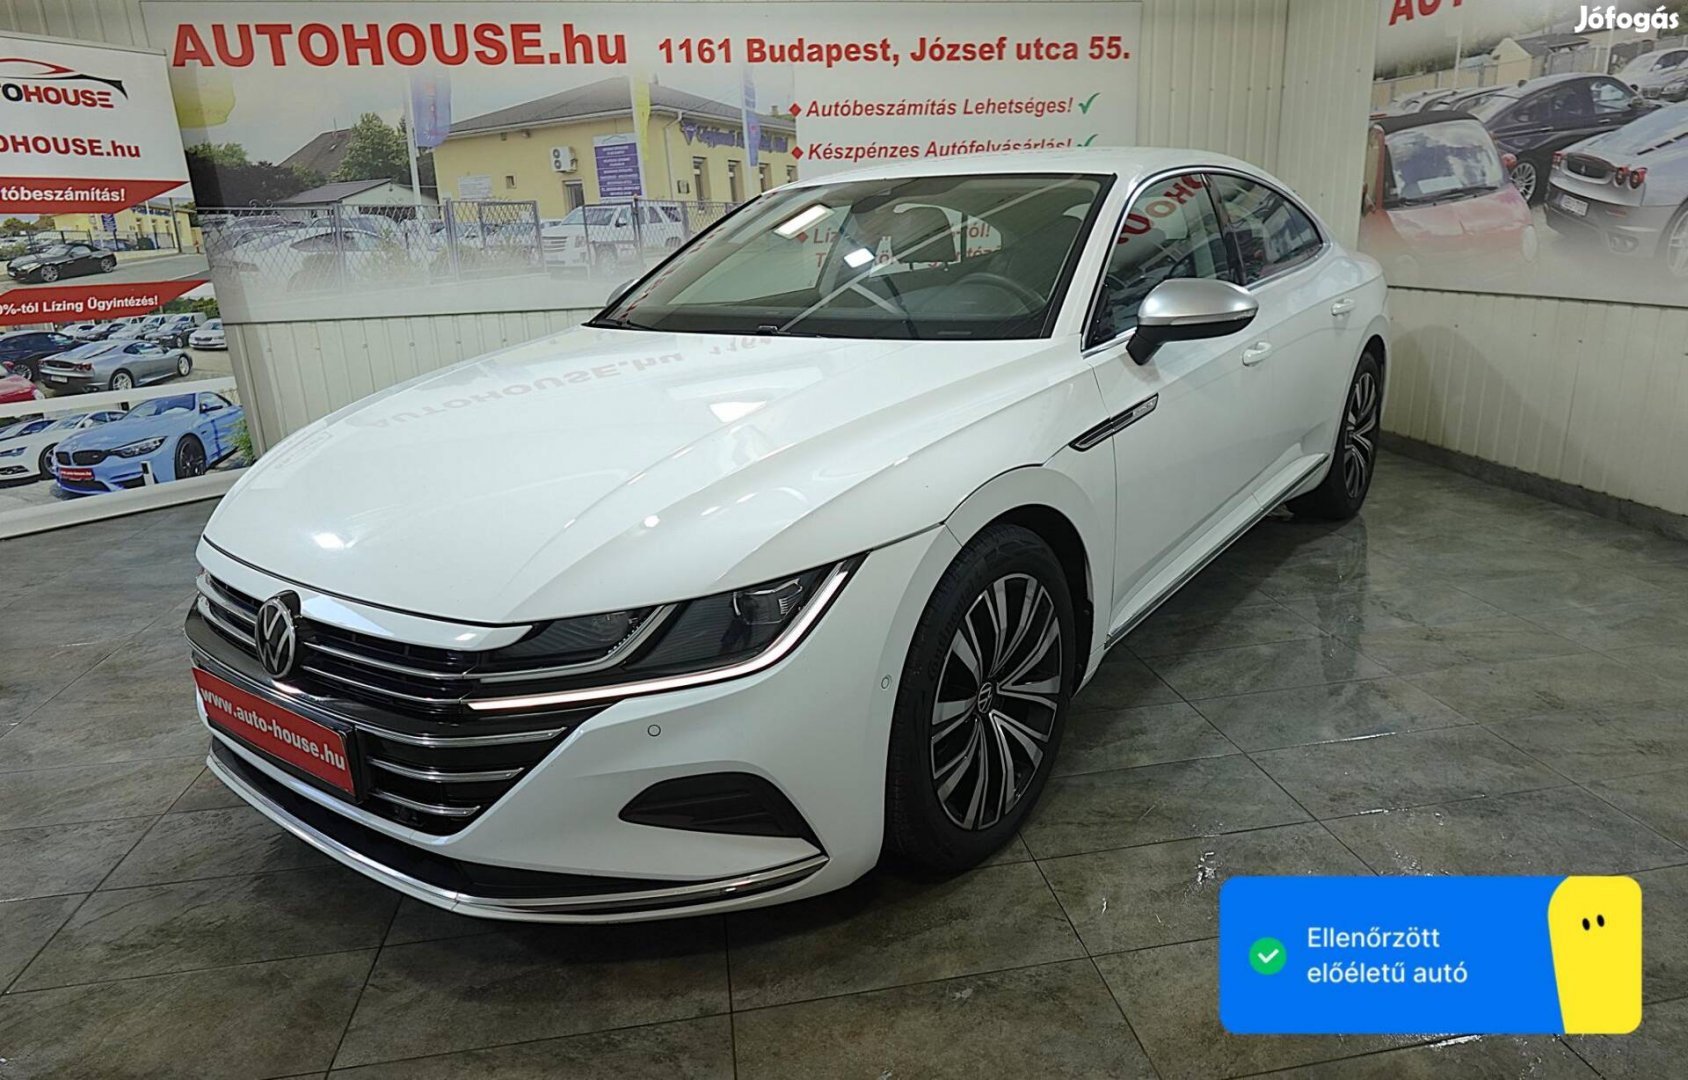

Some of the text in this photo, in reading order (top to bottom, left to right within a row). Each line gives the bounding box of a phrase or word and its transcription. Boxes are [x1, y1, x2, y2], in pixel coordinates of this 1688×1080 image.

[1389, 0, 1461, 26] AU
[172, 23, 627, 67] AUTOHOUSE.hu
[658, 35, 1131, 68] 1161 Budapest, József utca 55.
[0, 83, 114, 109] OHOUSE
[806, 97, 1074, 118] Autóbeszámítás Lehetséges!
[808, 141, 920, 163] Készpénzes
[43, 301, 84, 313] Lízing
[87, 295, 158, 312] Ügyintézés!
[200, 687, 346, 771] www.auto-house.hu
